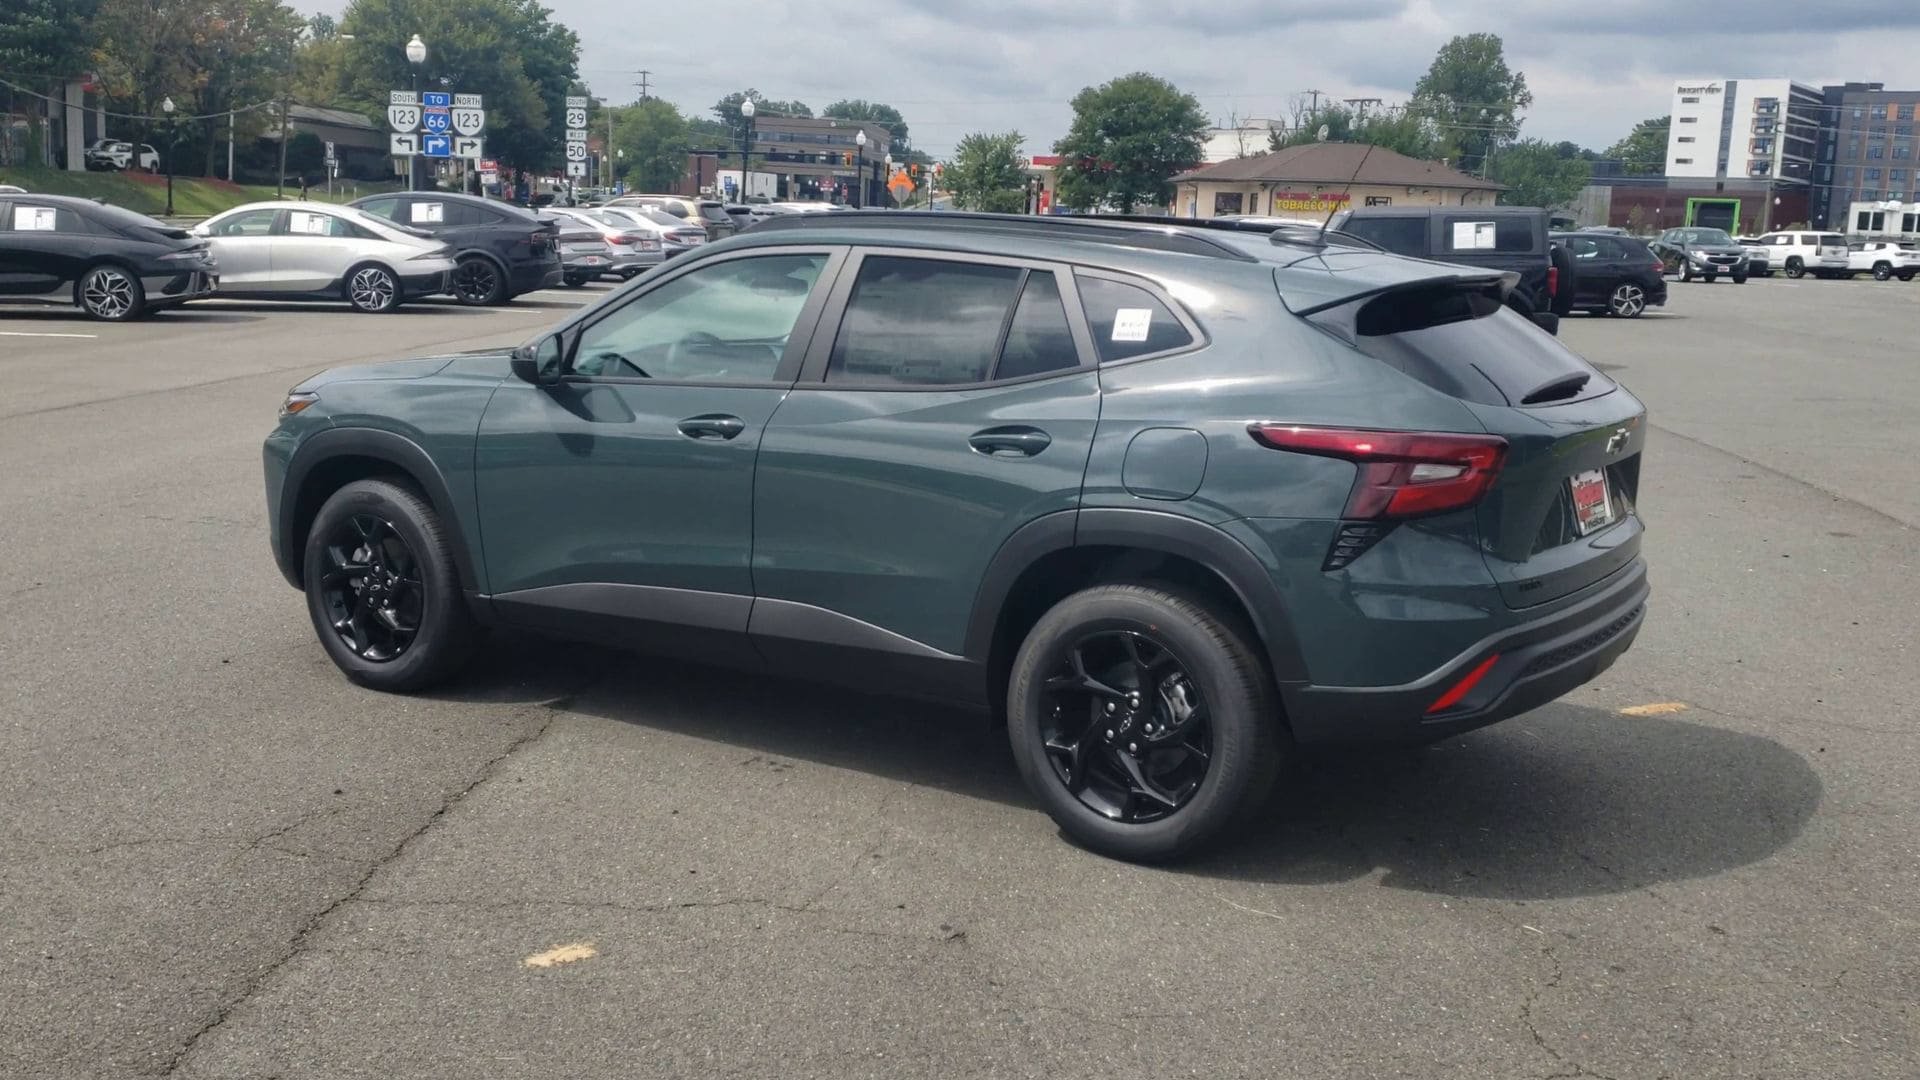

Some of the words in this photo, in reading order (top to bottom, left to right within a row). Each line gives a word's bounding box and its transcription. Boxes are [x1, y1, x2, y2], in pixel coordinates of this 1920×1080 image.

[392, 93, 416, 103] SOUTH
[430, 95, 443, 104] TO
[456, 96, 480, 106] NORTH
[393, 109, 416, 125] 123
[427, 115, 446, 128] 66
[457, 113, 480, 128] 123
[568, 112, 584, 124] 29
[568, 145, 585, 158] 50
[1276, 200, 1325, 211] TOBACCO
